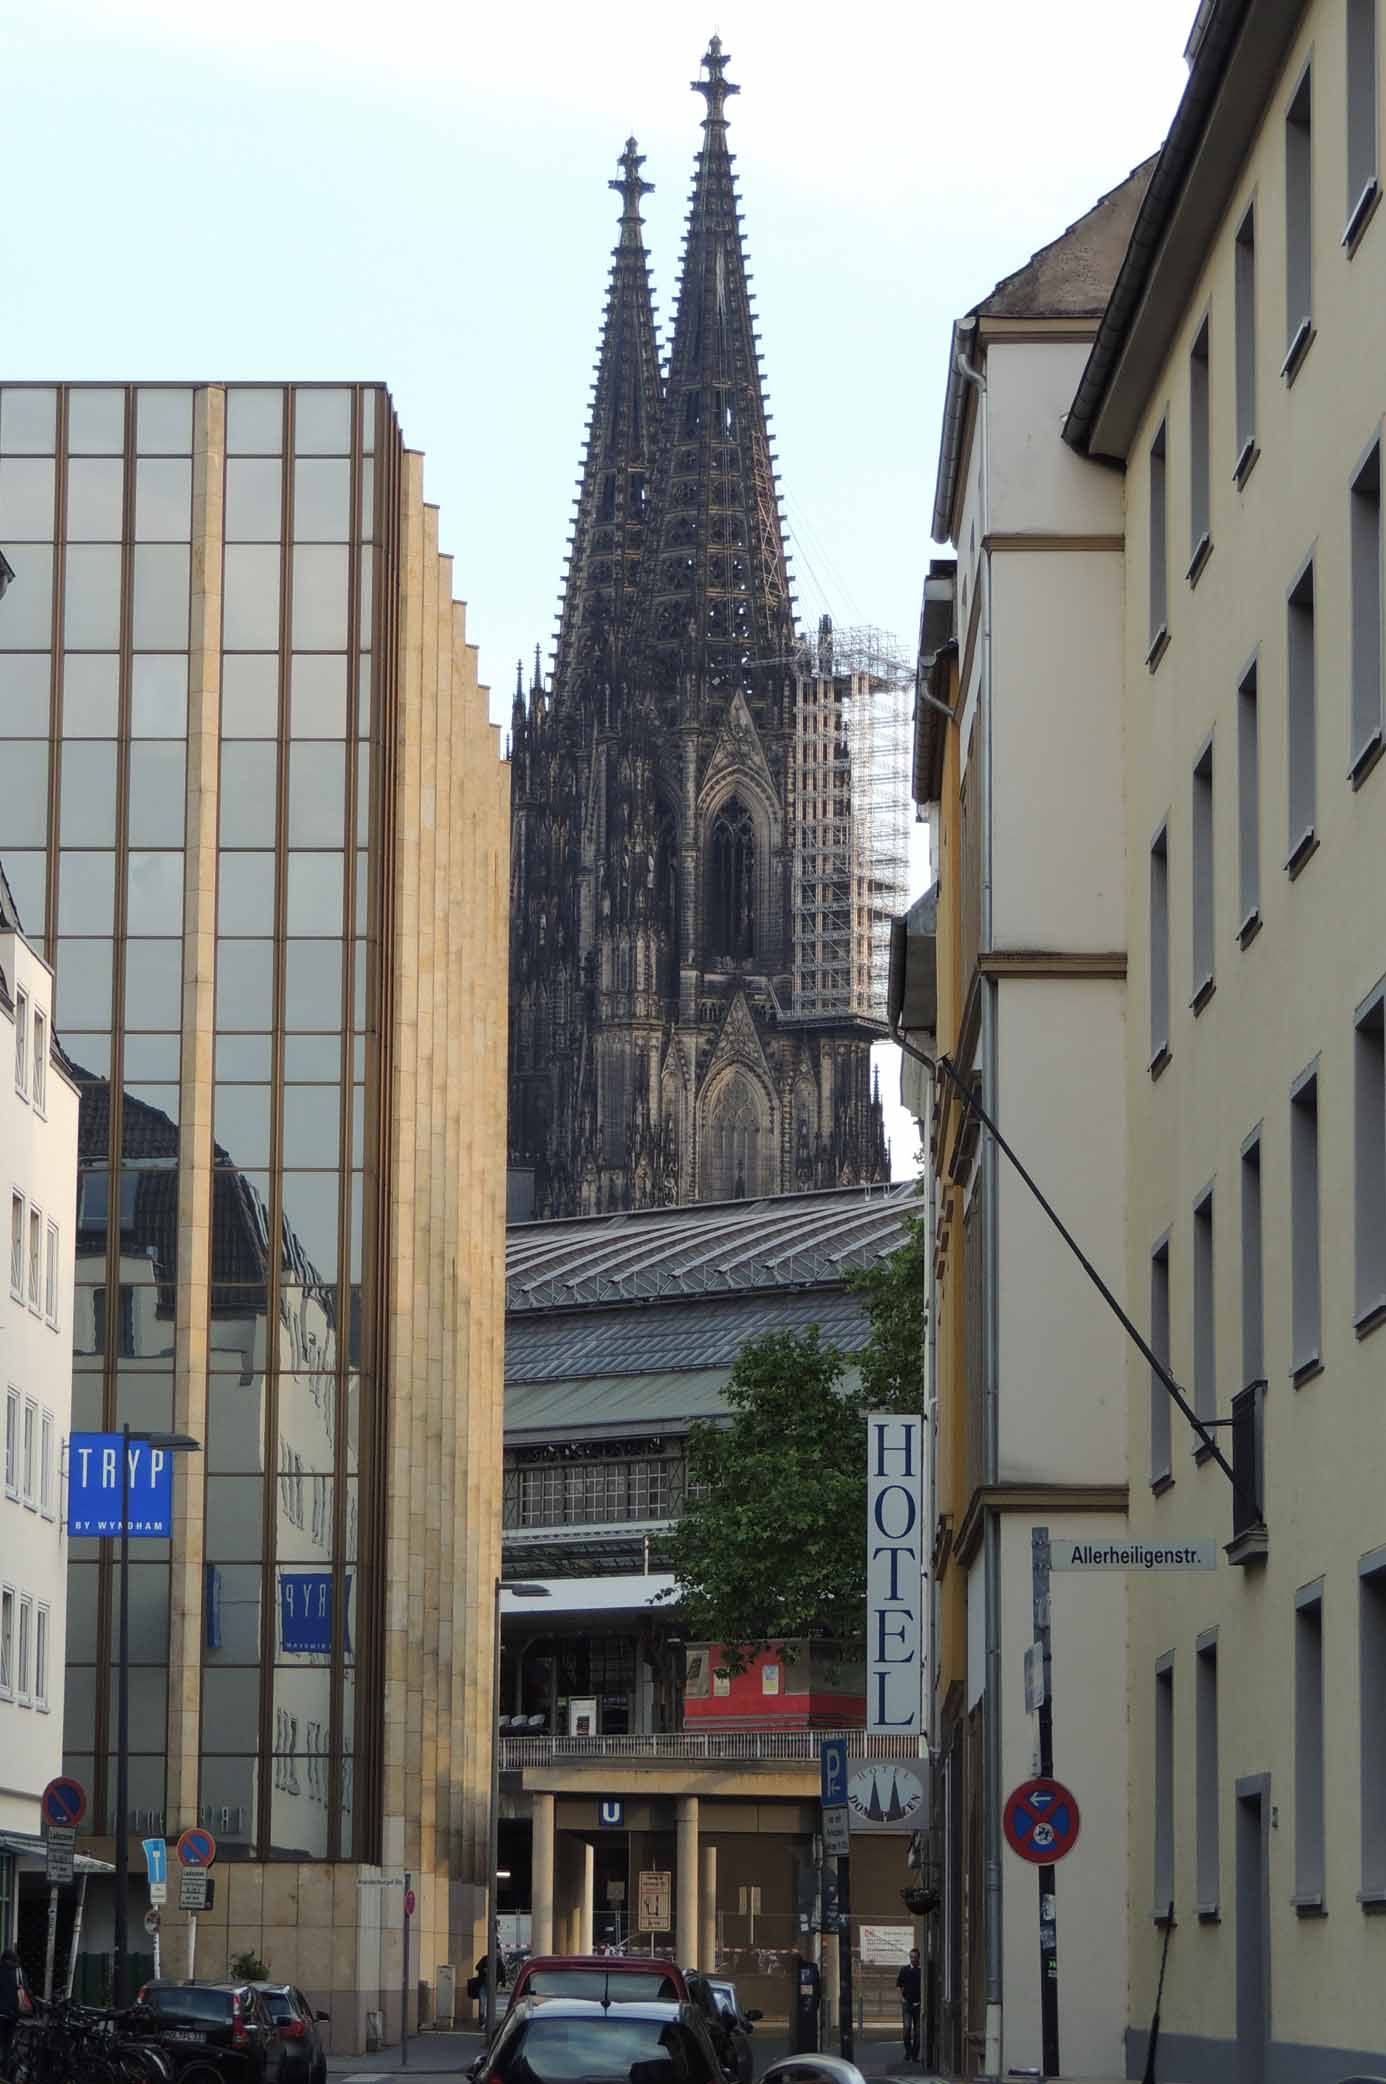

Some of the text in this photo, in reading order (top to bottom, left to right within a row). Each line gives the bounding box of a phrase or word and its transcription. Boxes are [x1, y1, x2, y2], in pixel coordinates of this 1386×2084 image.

[78, 1448, 164, 1489] TRYP
[75, 1521, 90, 1530] BY
[1071, 1545, 1201, 1568] Allerheiligenstr.
[872, 1423, 917, 1726] HOTEL
[827, 1749, 841, 1798] P
[602, 1801, 620, 1823] U
